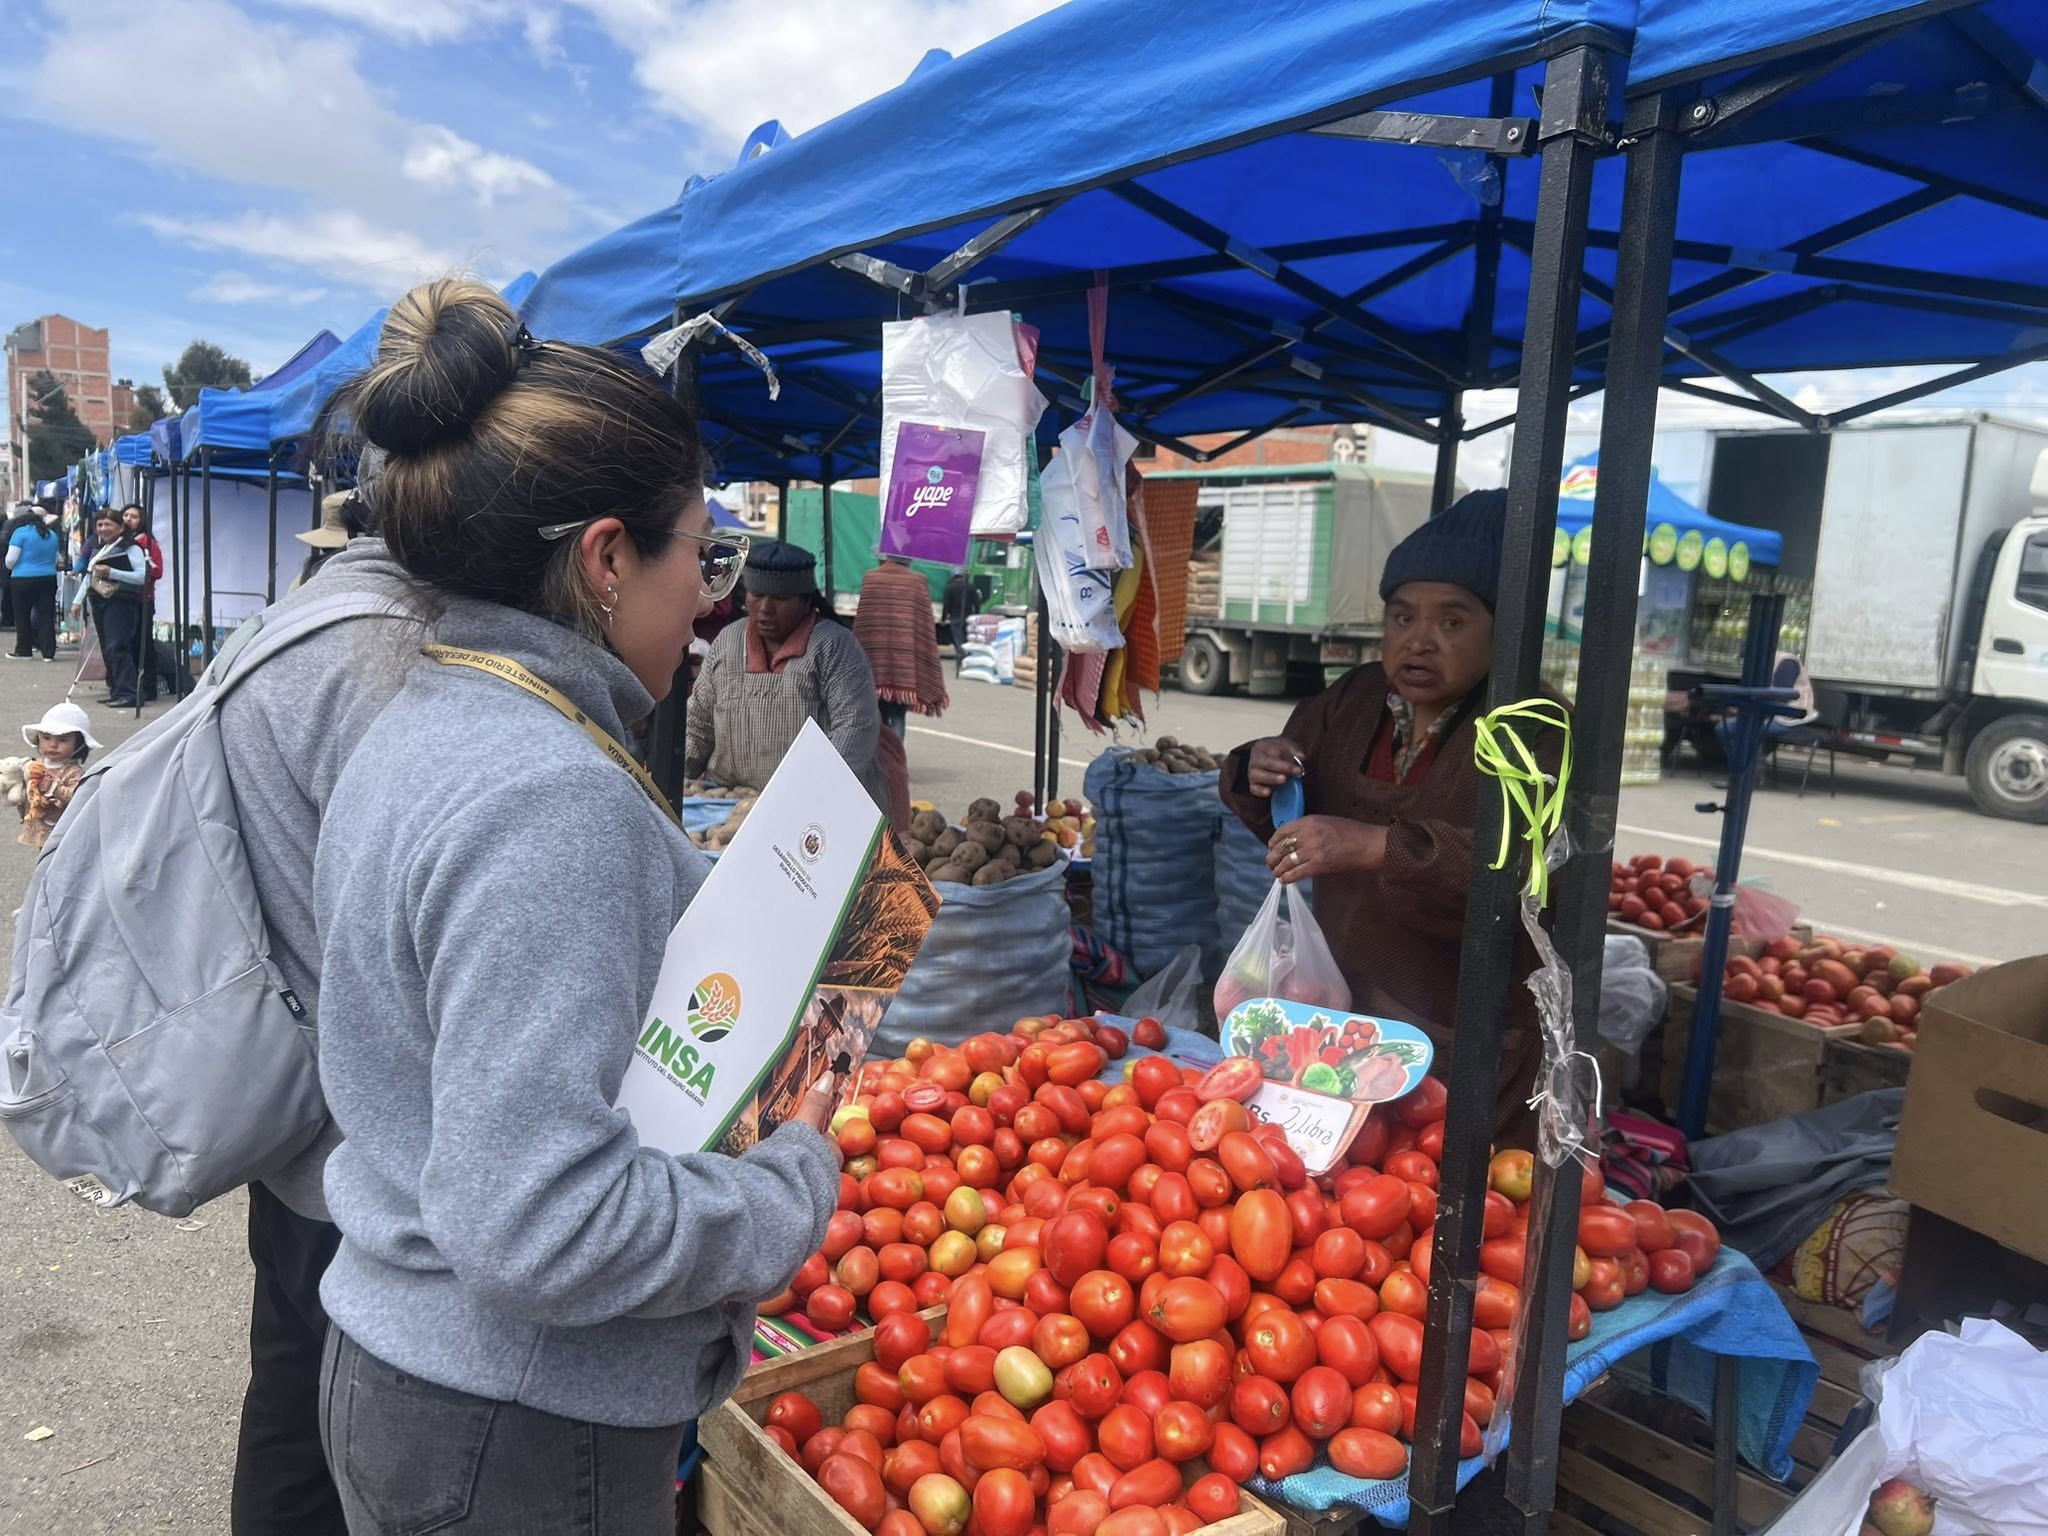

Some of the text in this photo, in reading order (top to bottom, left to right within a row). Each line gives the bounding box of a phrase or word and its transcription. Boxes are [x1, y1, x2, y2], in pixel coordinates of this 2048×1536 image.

[905, 486, 954, 517] yape
[469, 655, 485, 664] DE
[486, 658, 550, 695] MINISTERIO
[607, 743, 629, 769] AGUA
[772, 844, 797, 873] DESARROLLO
[779, 862, 791, 878] RURAL
[794, 880, 805, 893] AGUA
[638, 1017, 716, 1100] INSA
[633, 1047, 705, 1107] NSTITUTO DEL SEGURO AGRARIO
[92, 1189, 104, 1201] 23
